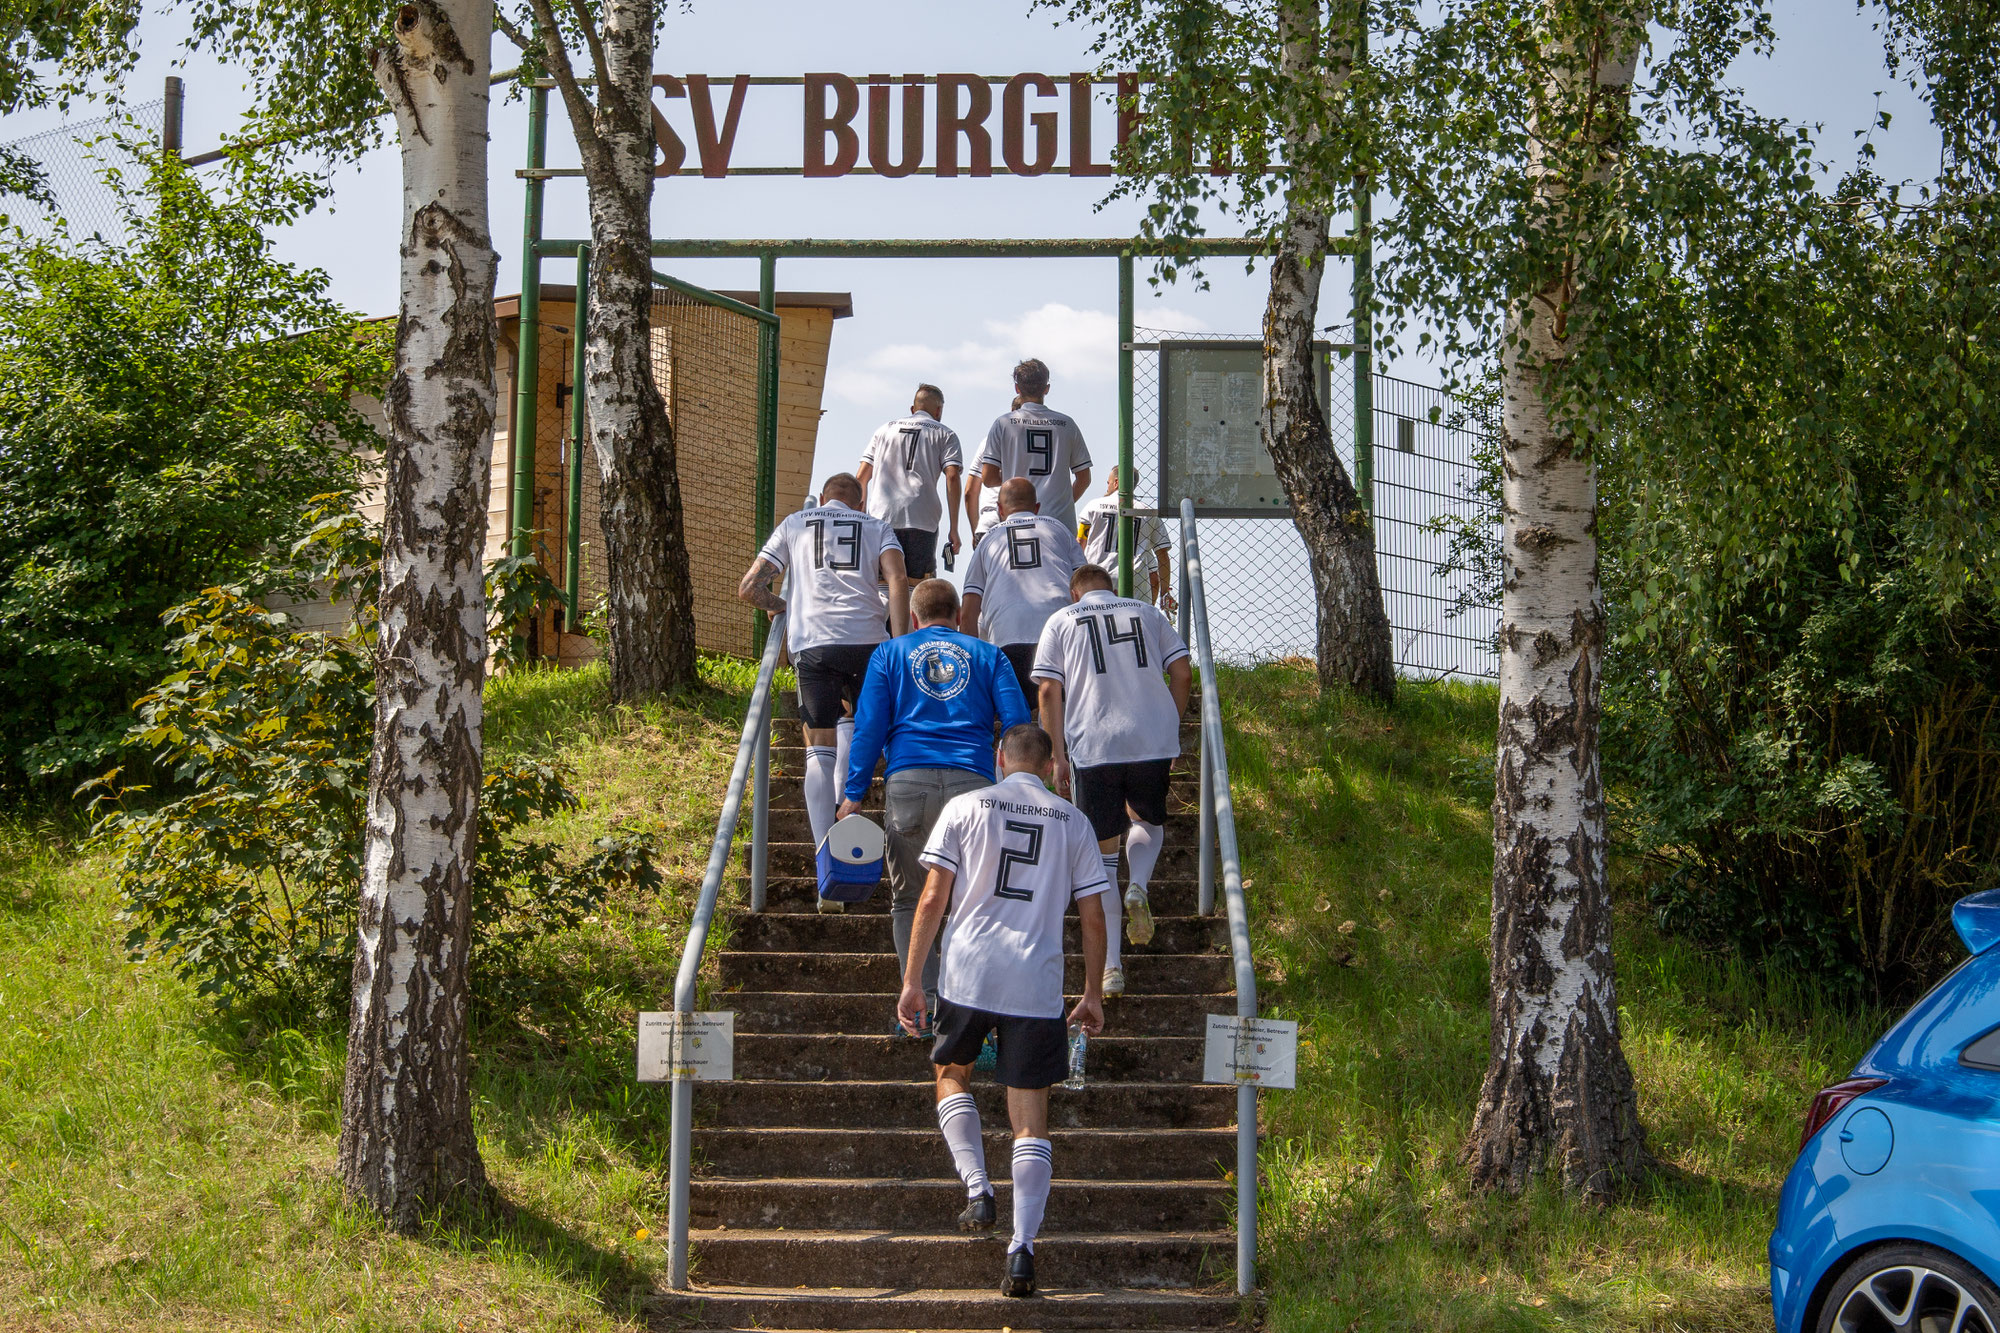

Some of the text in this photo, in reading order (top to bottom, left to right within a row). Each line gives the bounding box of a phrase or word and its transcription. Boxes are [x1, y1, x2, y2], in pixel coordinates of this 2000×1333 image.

[1022, 418, 1068, 427] WILHERMSDORF
[898, 427, 922, 471] 7
[1026, 429, 1053, 476] 9
[800, 511, 870, 521] TSV WILHERMSDORF
[806, 519, 863, 571] 13
[1006, 523, 1042, 571] 6
[1066, 601, 1142, 617] TSV WILHERMSDORF
[908, 641, 972, 660] TSV WILHERMSDORF
[1075, 613, 1149, 675] 14
[979, 798, 1071, 823] TSV WILHERMSDORF
[993, 819, 1045, 903] 2
[1212, 1022, 1229, 1030] Zutritt
